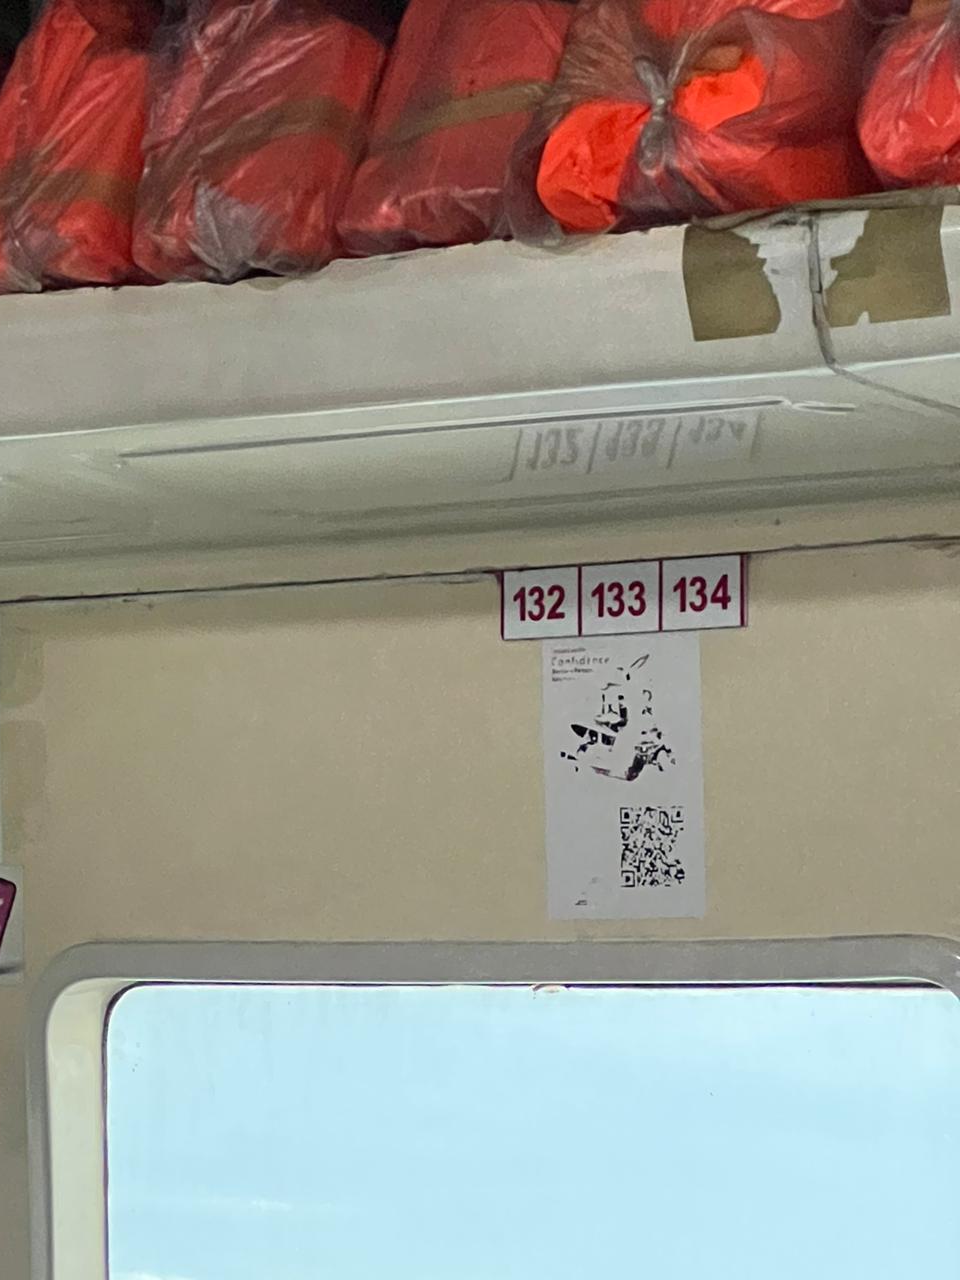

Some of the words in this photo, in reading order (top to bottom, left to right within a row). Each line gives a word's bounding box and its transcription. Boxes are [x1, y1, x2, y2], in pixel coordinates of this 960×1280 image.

[513, 585, 566, 622] 132
[590, 580, 647, 618] 133
[672, 573, 732, 613] 134
